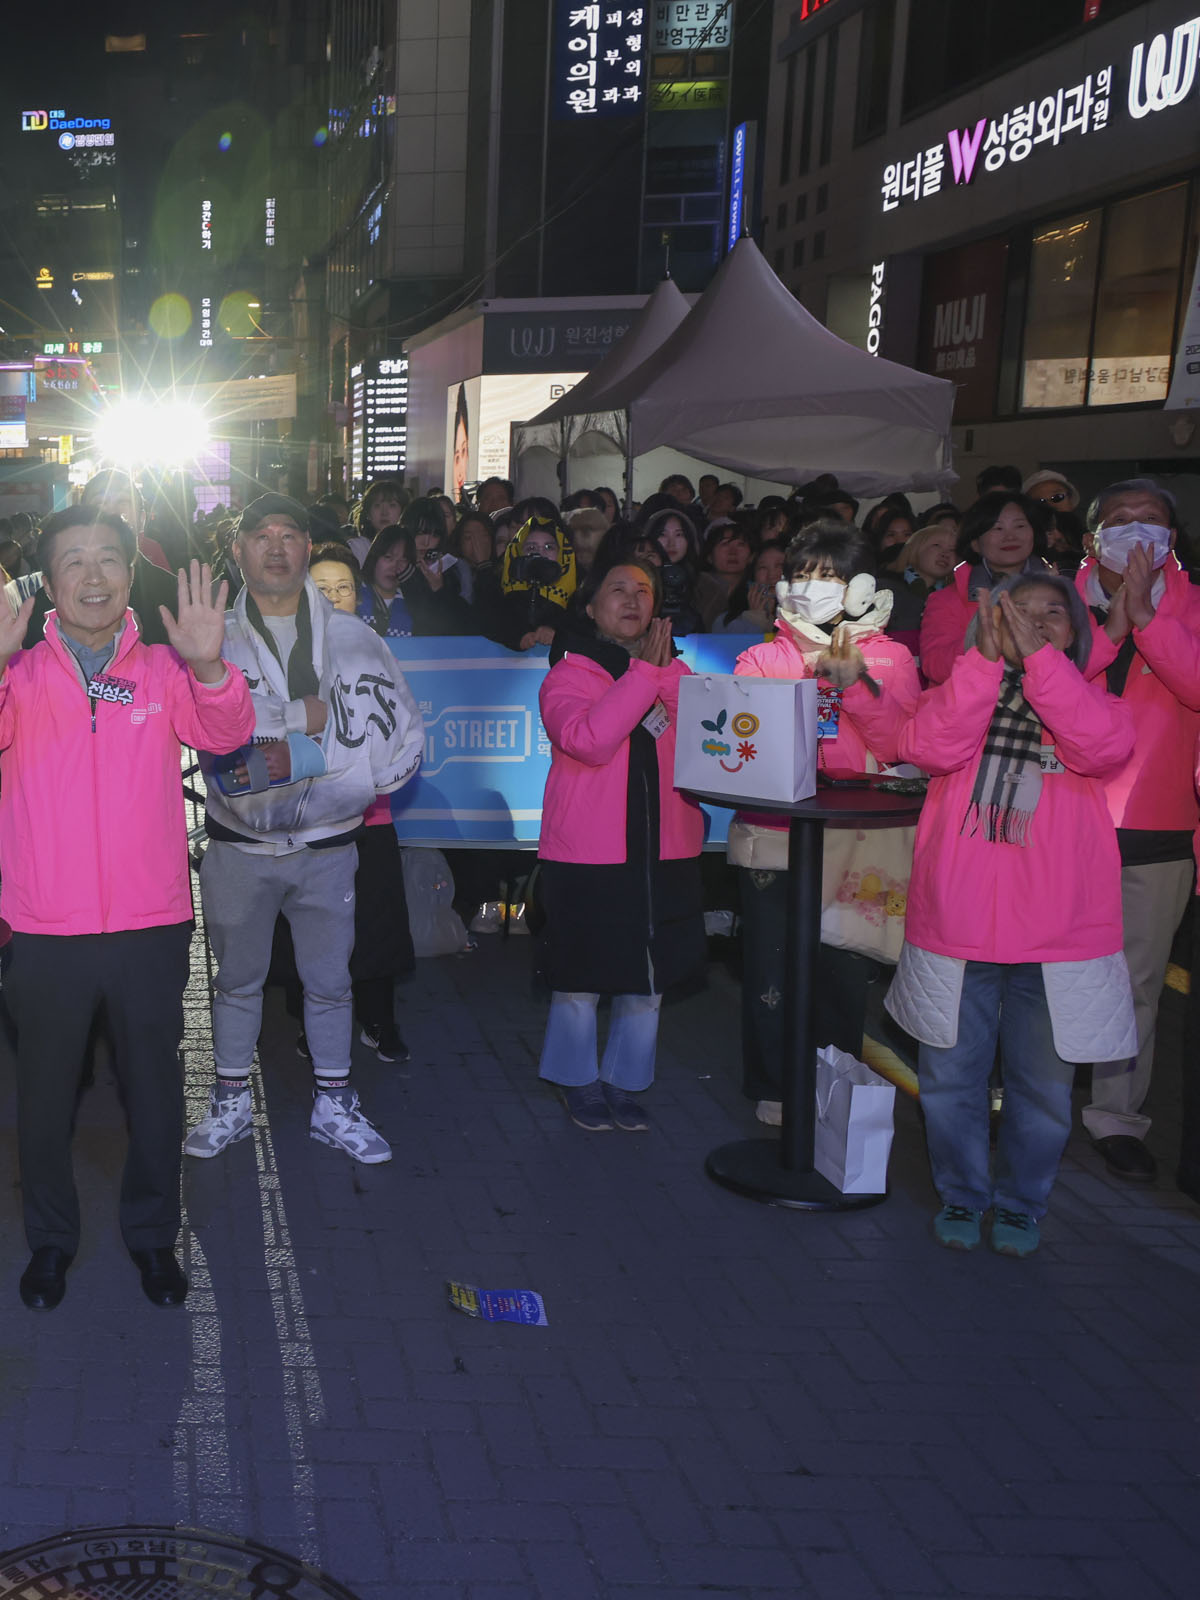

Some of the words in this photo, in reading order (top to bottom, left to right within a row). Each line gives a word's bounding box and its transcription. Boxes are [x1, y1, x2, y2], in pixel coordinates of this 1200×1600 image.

[566, 0, 600, 114] 케이의원
[622, 8, 644, 102] 성형외과
[49, 118, 111, 129] DaeDong
[866, 261, 886, 357] PAGO
[933, 293, 987, 348] MUJI
[88, 681, 134, 705] 전성수
[444, 719, 519, 749] STREET
